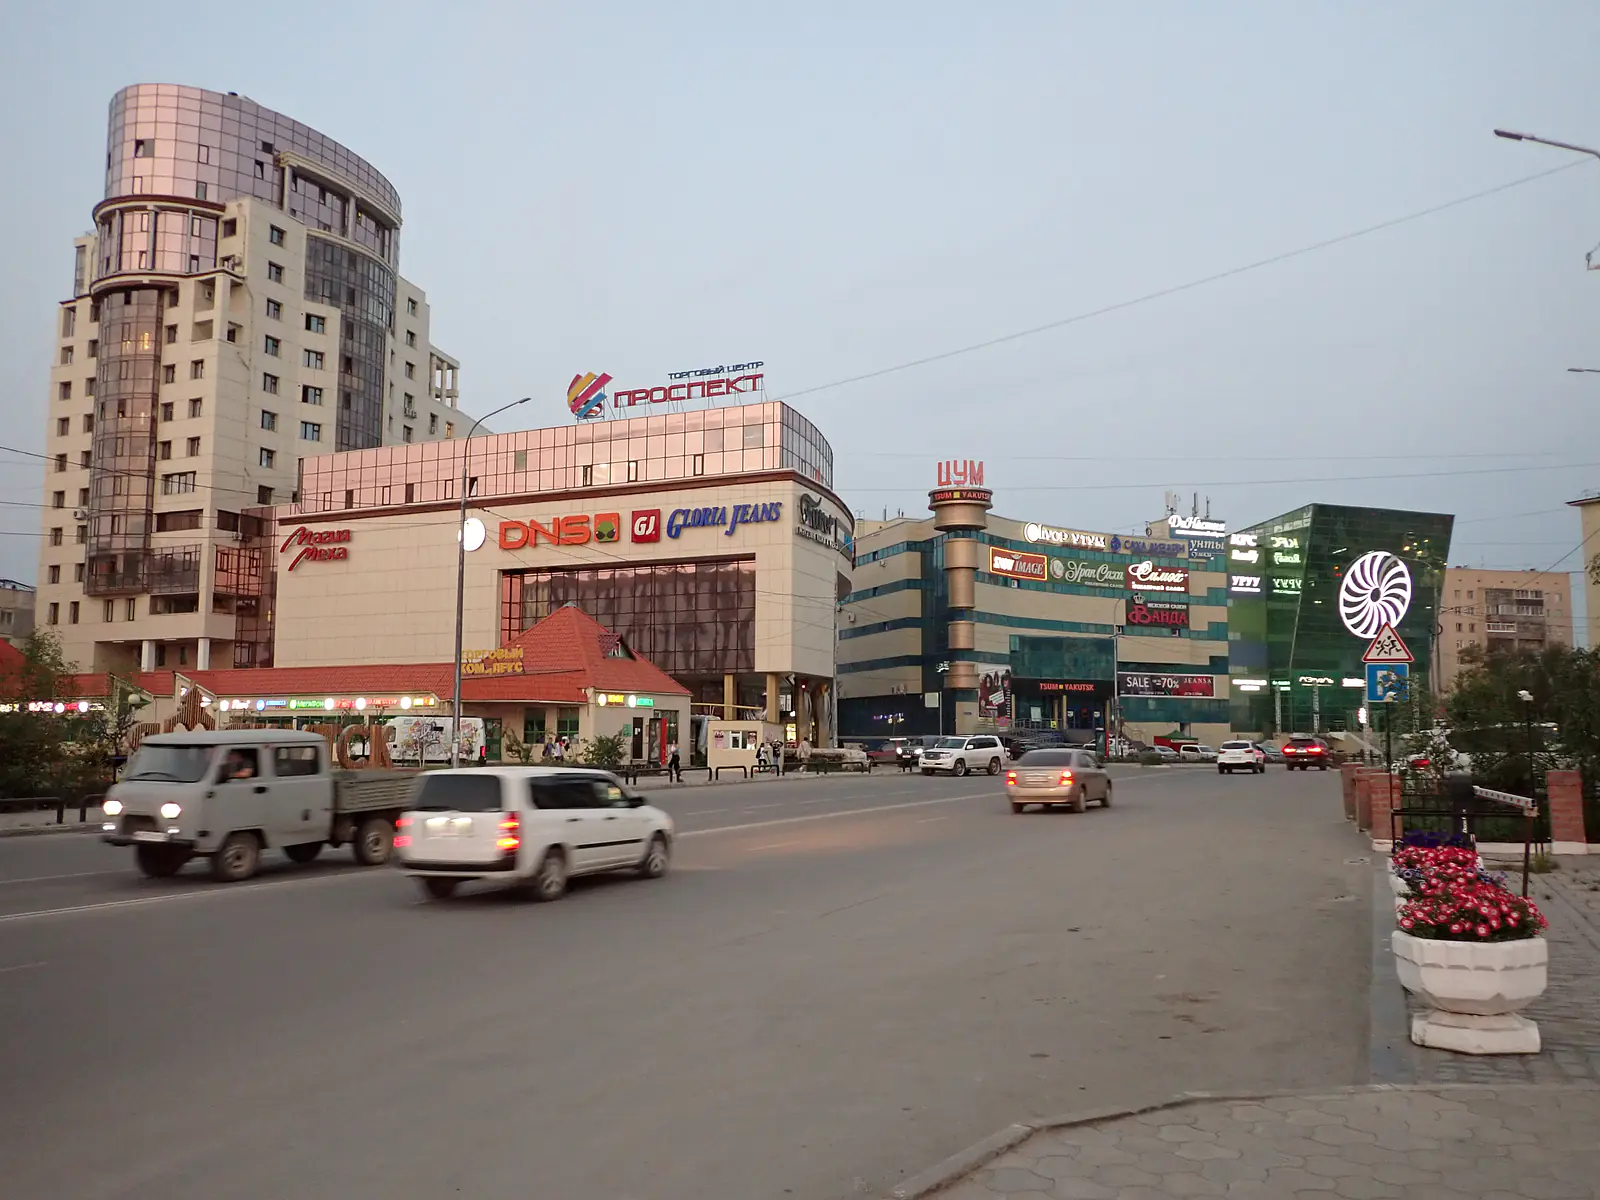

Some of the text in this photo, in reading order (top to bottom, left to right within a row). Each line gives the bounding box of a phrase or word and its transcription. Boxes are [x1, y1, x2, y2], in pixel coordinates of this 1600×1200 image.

[668, 361, 764, 380] ТОРГОВЫЙ ЦЕНТР
[614, 373, 764, 408] ПРОСПЕКТ
[938, 460, 984, 486] ЦУМ
[634, 515, 655, 537] GJ
[667, 507, 727, 539] GLORIA
[725, 502, 782, 536] JEANS
[280, 526, 351, 553] Магия
[499, 514, 590, 550] DNS
[1230, 534, 1257, 546] KFC
[288, 547, 348, 571] Меха
[1014, 561, 1043, 575] IMAGE
[1065, 561, 1124, 582] Уран Саха
[1065, 683, 1094, 691] YAKUTSK
[1126, 676, 1150, 688] SALE
